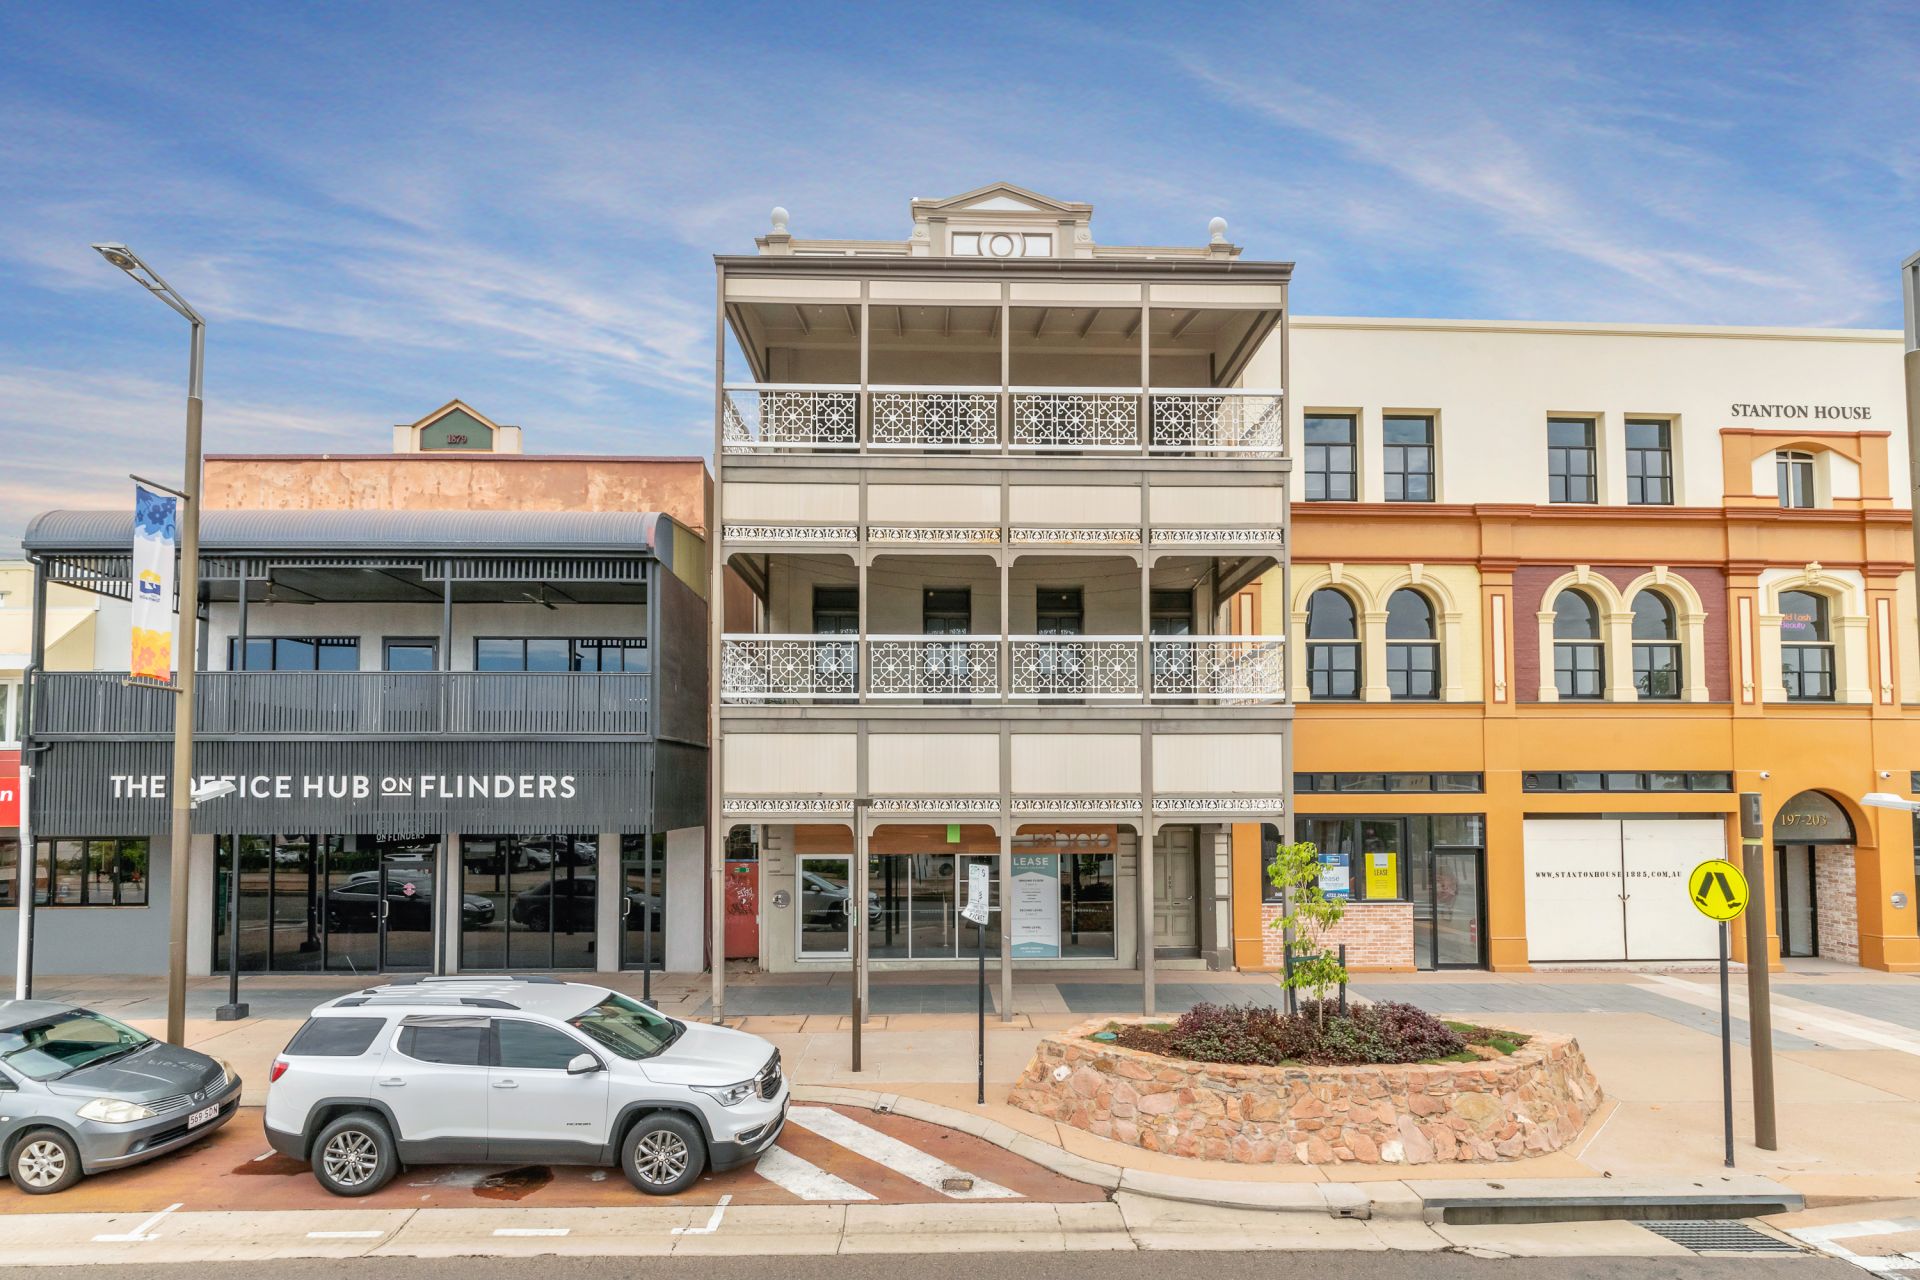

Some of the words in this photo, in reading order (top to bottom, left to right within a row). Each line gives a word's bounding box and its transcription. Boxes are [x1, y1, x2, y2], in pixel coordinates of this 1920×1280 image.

[1731, 404, 1808, 419] STANTON
[1814, 405, 1872, 420] HOUSE
[110, 775, 165, 798] THE
[303, 775, 370, 798] HUB
[381, 776, 412, 796] ON
[420, 775, 576, 798] FLINDERS
[1781, 814, 1828, 826] 197-203
[1013, 857, 1049, 866] LEASE
[190, 1112, 203, 1125] 569
[204, 1106, 218, 1119] SDN
